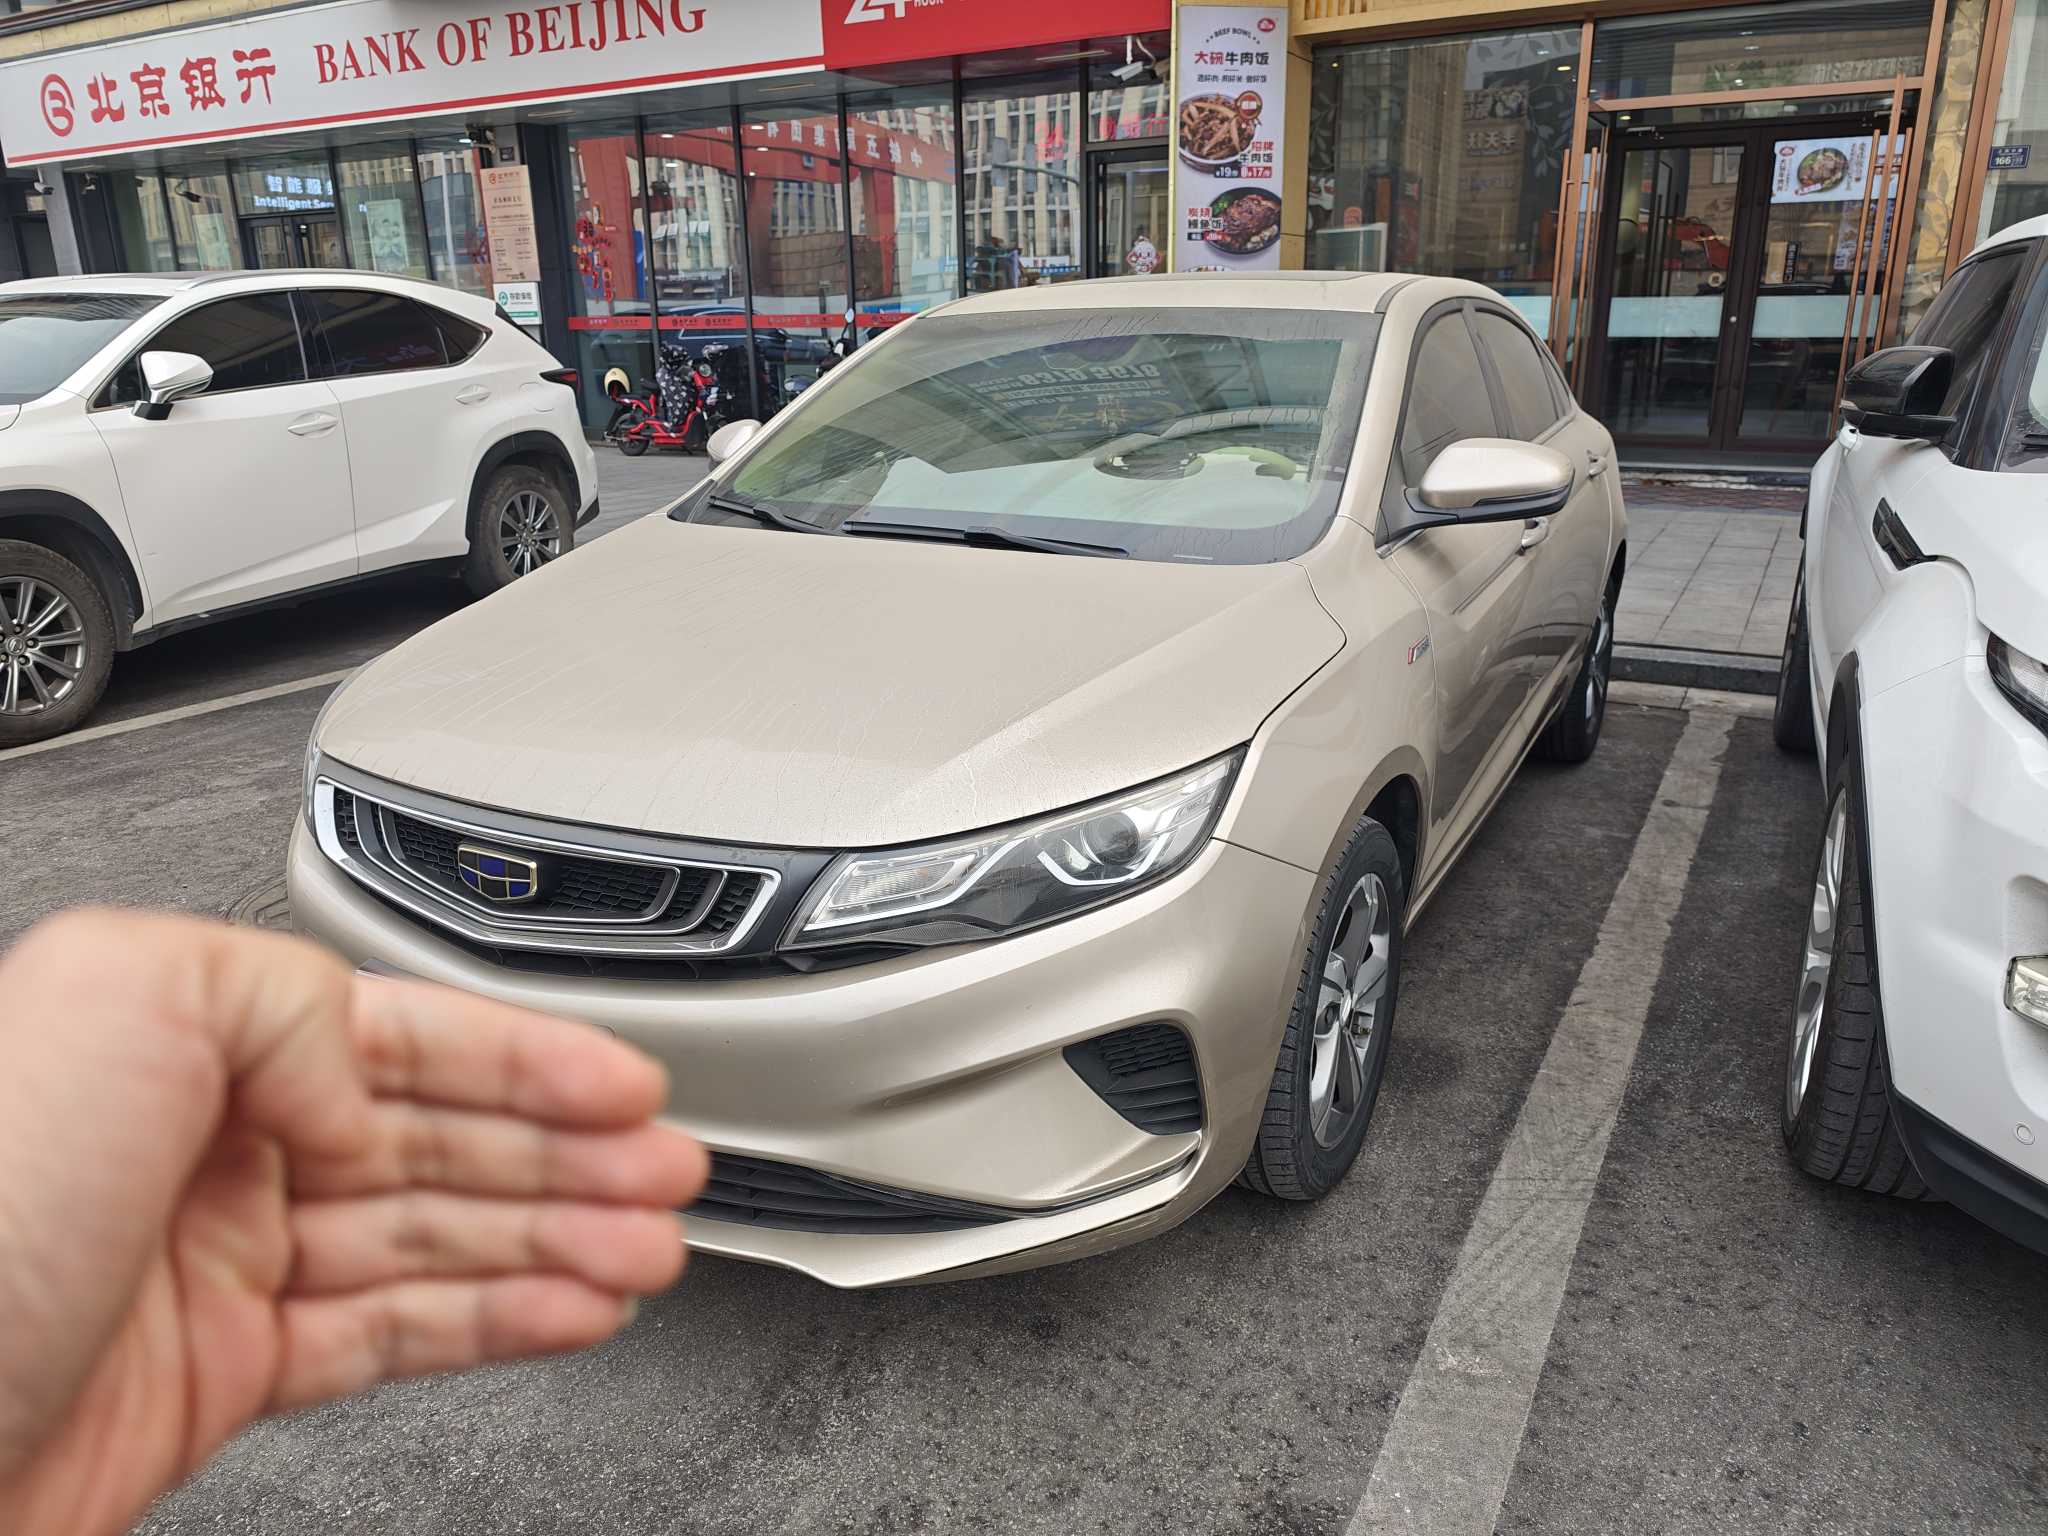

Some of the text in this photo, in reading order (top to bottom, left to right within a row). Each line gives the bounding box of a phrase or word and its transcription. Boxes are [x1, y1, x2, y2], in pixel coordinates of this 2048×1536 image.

[1214, 28, 1251, 38] BEEF BOWL
[313, 0, 708, 85] BANK OF BEIJING
[1194, 51, 1269, 66] 大碗牛肉饭
[87, 47, 278, 126] 北京银行
[1252, 141, 1274, 152] 招牌
[1240, 153, 1273, 163] 牛肉饭
[1995, 156, 2011, 165] 166
[254, 195, 311, 211] Intelligent
